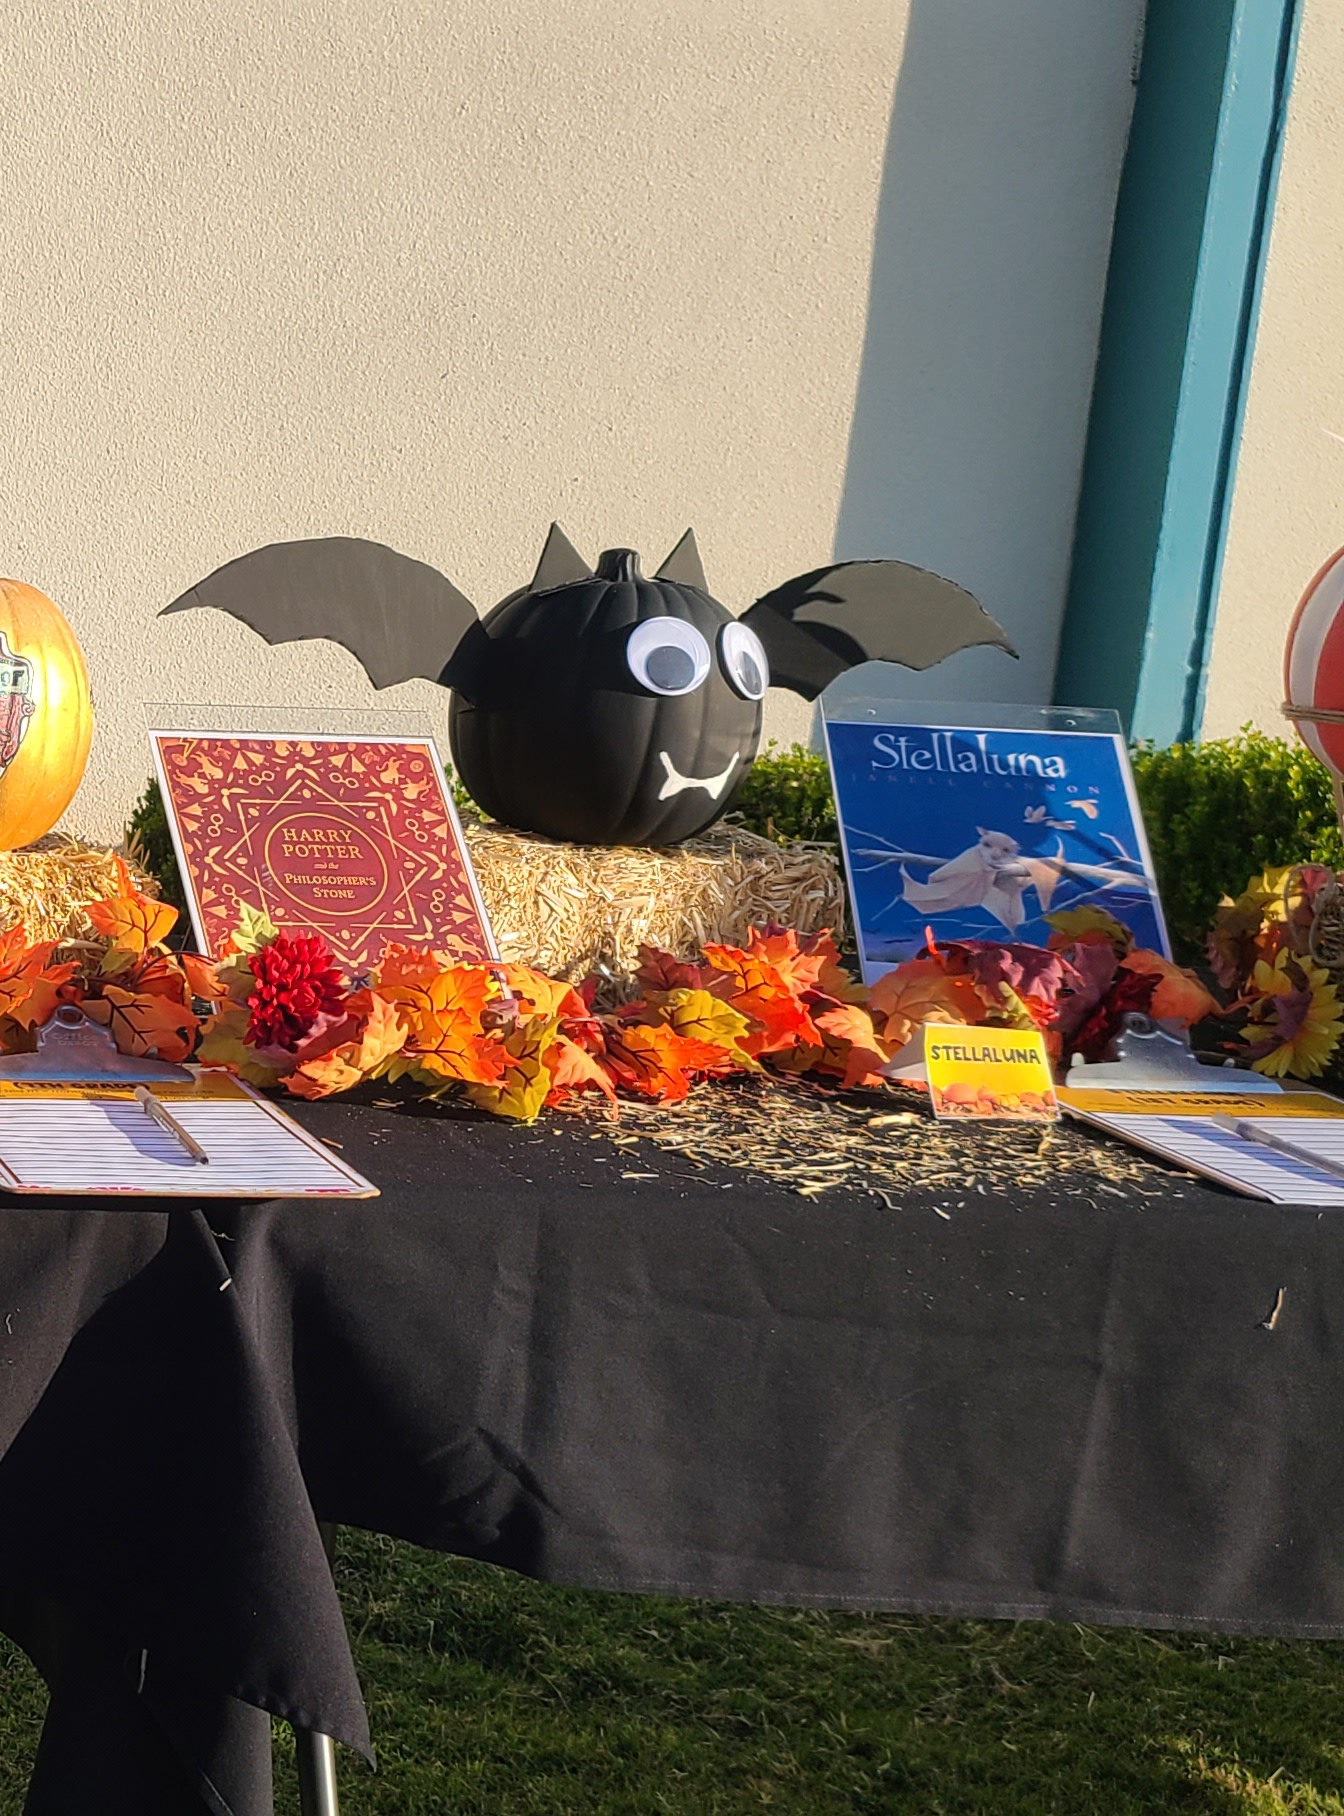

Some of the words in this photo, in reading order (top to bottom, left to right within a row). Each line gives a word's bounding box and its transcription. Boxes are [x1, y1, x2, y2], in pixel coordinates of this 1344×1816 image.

[872, 732, 1068, 779] Stellaluna
[983, 779, 1100, 795] CANNON
[282, 828, 352, 843] HARRY
[282, 844, 364, 859] POTTER
[284, 873, 377, 886] PHILOSOPHER'S
[313, 887, 356, 899] STONE
[931, 1045, 1041, 1065] STELLALUNA
